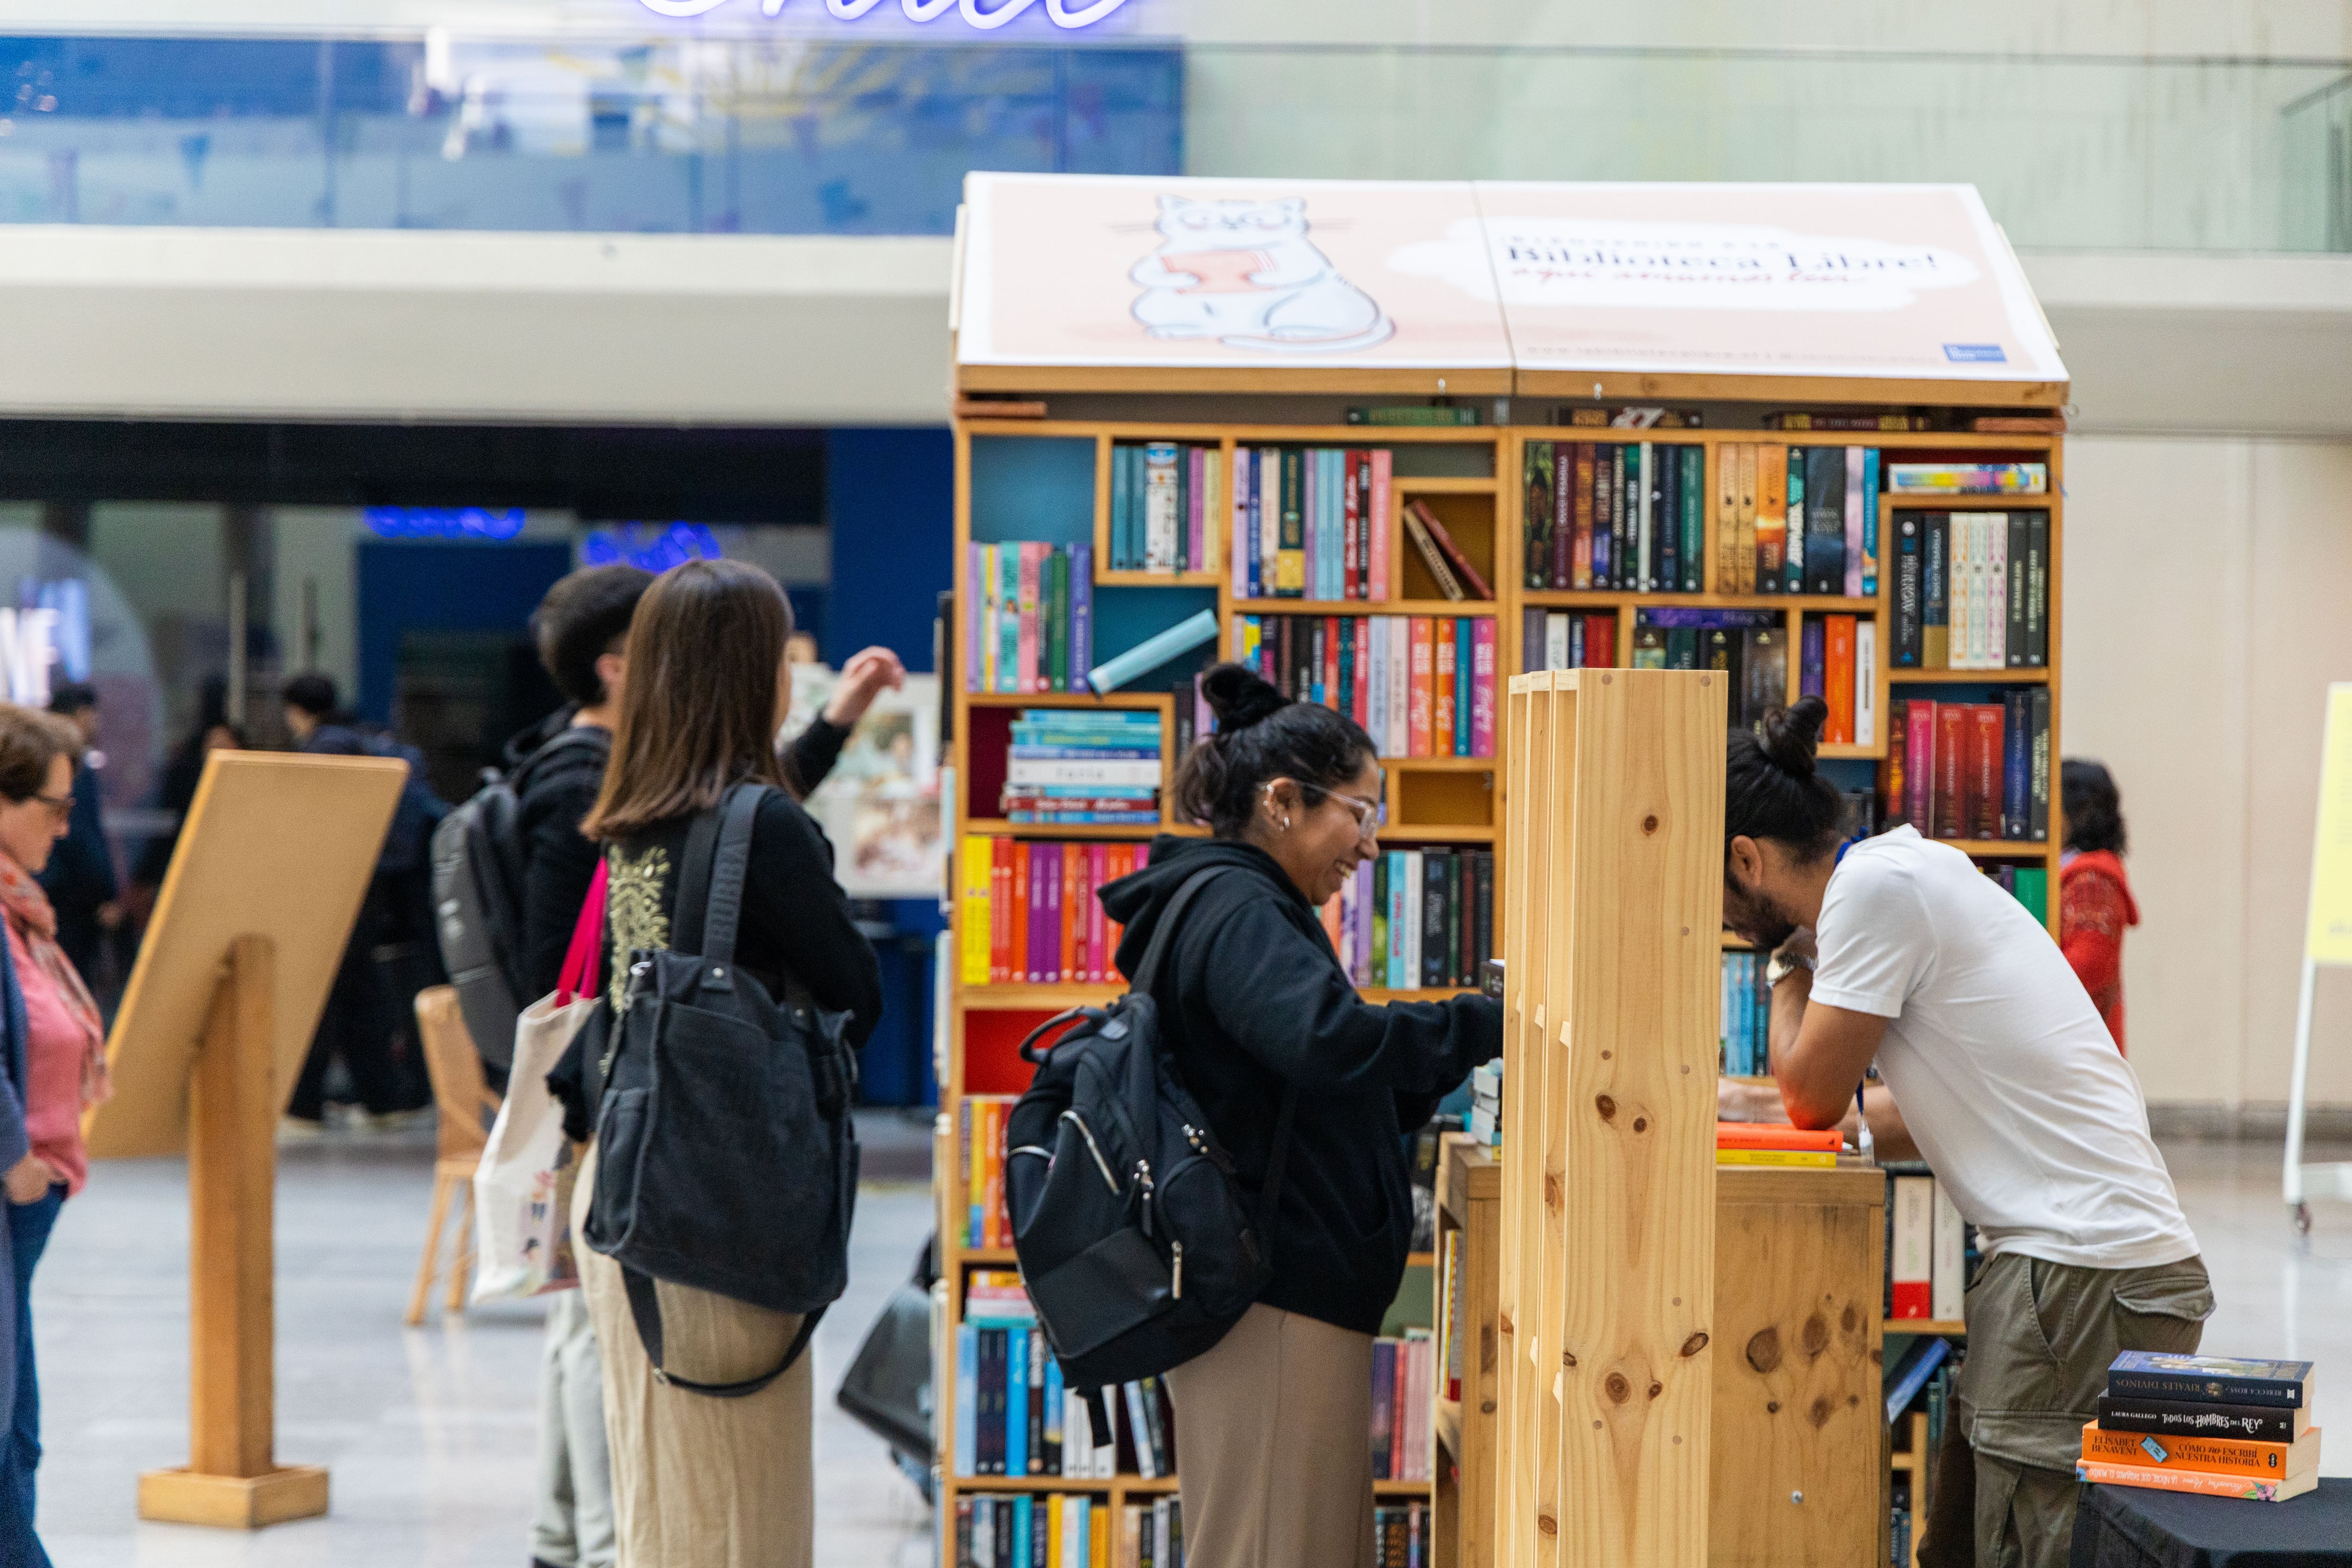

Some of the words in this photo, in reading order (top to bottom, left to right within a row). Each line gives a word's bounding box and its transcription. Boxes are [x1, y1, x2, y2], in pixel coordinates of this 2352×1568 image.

[1509, 247, 1761, 267] Biblioteca
[1788, 253, 1937, 270] Libre!
[2116, 1379, 2159, 1389] DIVINOS
[2163, 1382, 2201, 1393] RIVALES
[2162, 1413, 2182, 1424] TODOS
[2183, 1415, 2194, 1425] LOS
[2195, 1414, 2229, 1429] HOMBRES
[2242, 1417, 2263, 1433] REY
[2092, 1444, 2137, 1456] BENAVENT
[2178, 1442, 2206, 1454] CÓMO
[2222, 1445, 2258, 1458] ESCRIBÍ
[2175, 1452, 2217, 1463] NUESTRA
[2217, 1455, 2260, 1467] HISTORIA
